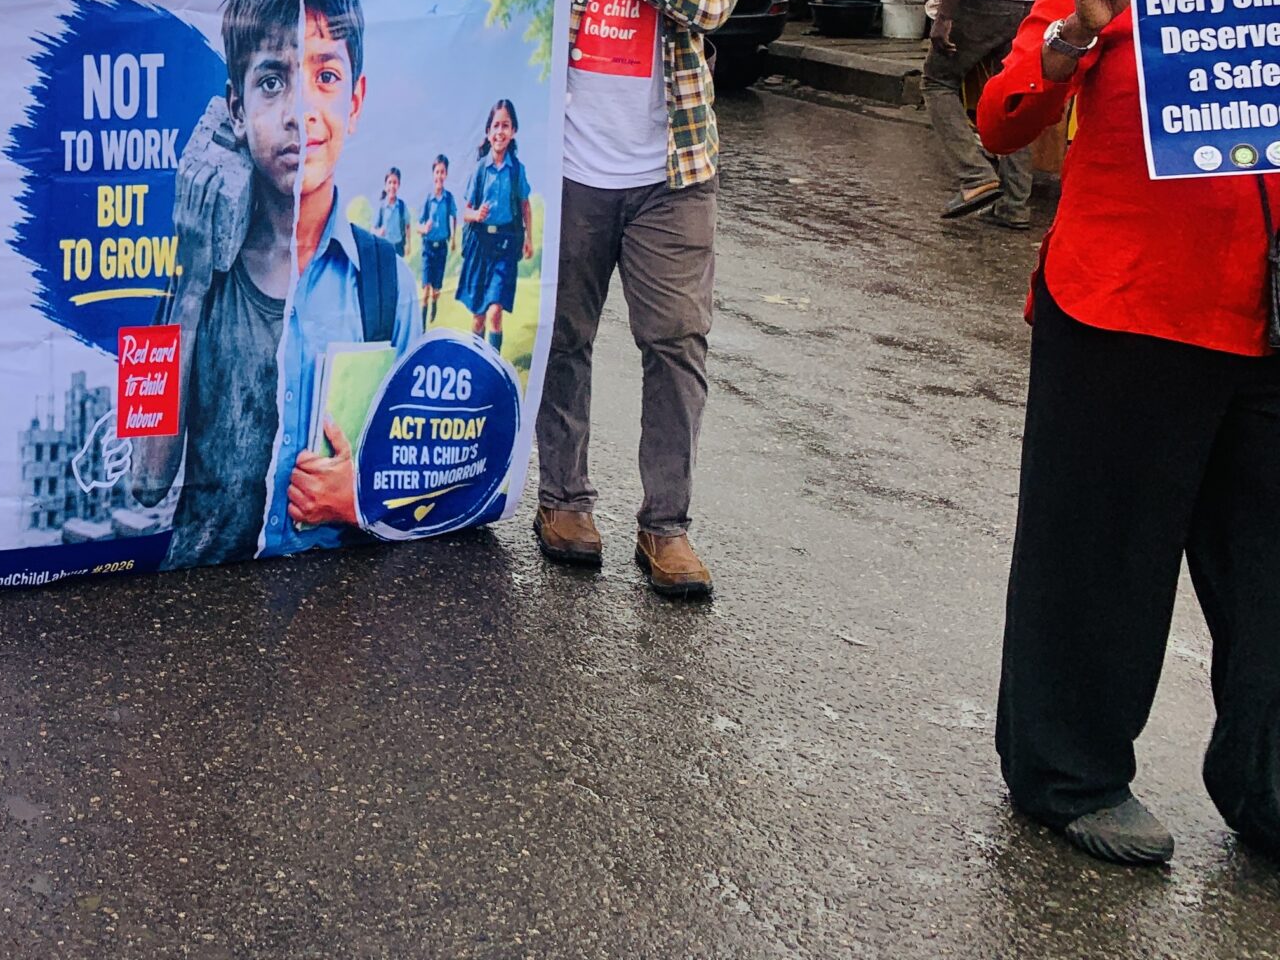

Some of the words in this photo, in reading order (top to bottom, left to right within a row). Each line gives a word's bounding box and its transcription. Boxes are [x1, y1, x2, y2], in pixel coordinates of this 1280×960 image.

[603, 0, 640, 18] child
[584, 17, 637, 40] labour
[1160, 22, 1280, 54] Deserve
[83, 53, 165, 120] NOT
[1189, 68, 1208, 92] a
[1213, 59, 1280, 90] Safe
[1162, 100, 1280, 133] Childho
[60, 130, 94, 172] TO
[97, 185, 149, 227] BUT
[59, 238, 93, 281] TO
[99, 236, 183, 280] GROW.
[121, 335, 150, 368] Red
[149, 338, 177, 364] card
[139, 371, 168, 396] child
[410, 365, 472, 401] 2026
[125, 404, 164, 430] labour
[389, 416, 426, 440] ACT
[430, 416, 487, 440] TODAY
[392, 445, 418, 465] FOR
[420, 445, 430, 465] A
[433, 443, 479, 465] CHILD'S
[373, 470, 420, 490] BETTER
[422, 457, 487, 489] TOMORROW.
[91, 559, 135, 574] #2026
